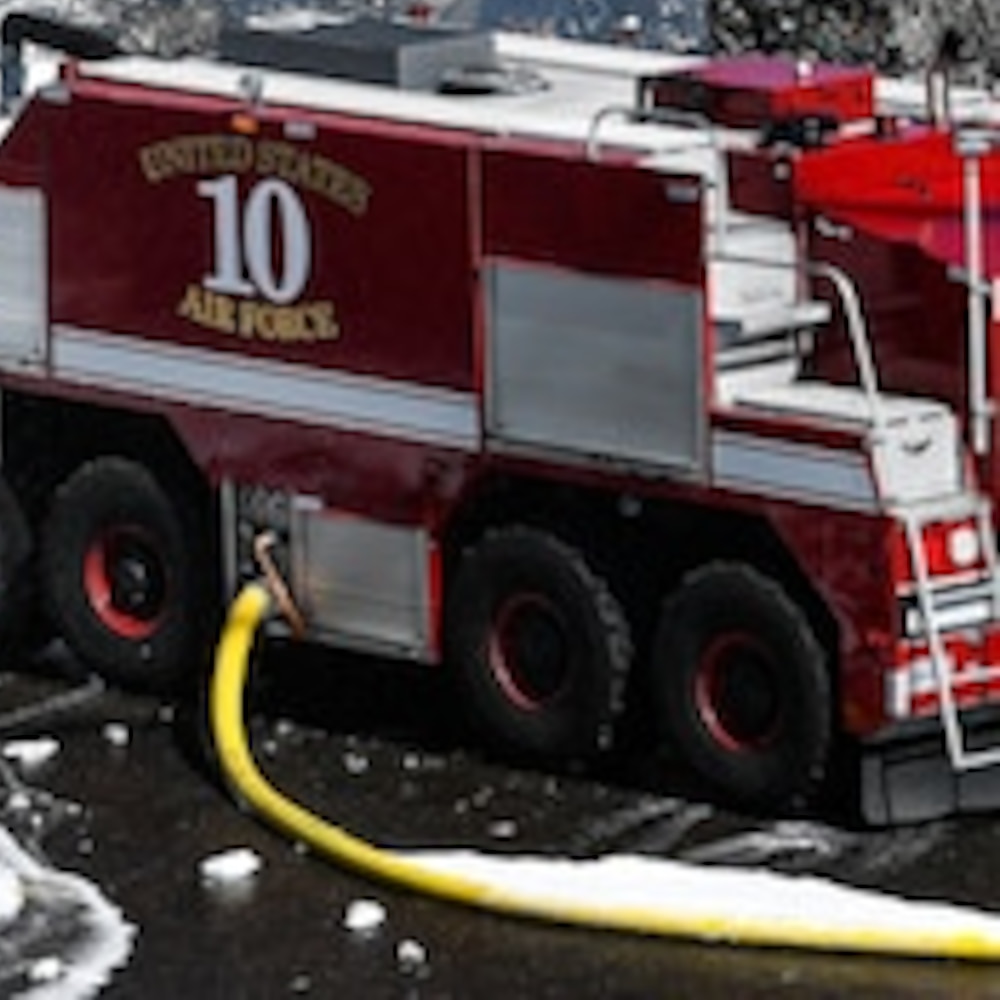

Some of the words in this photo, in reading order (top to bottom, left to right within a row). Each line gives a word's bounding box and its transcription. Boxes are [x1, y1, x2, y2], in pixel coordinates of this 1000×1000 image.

[139, 133, 253, 183] UNITED
[255, 139, 373, 217] STATES
[196, 174, 312, 305] 10
[176, 283, 236, 335] AIR
[238, 299, 340, 343] FORCE
